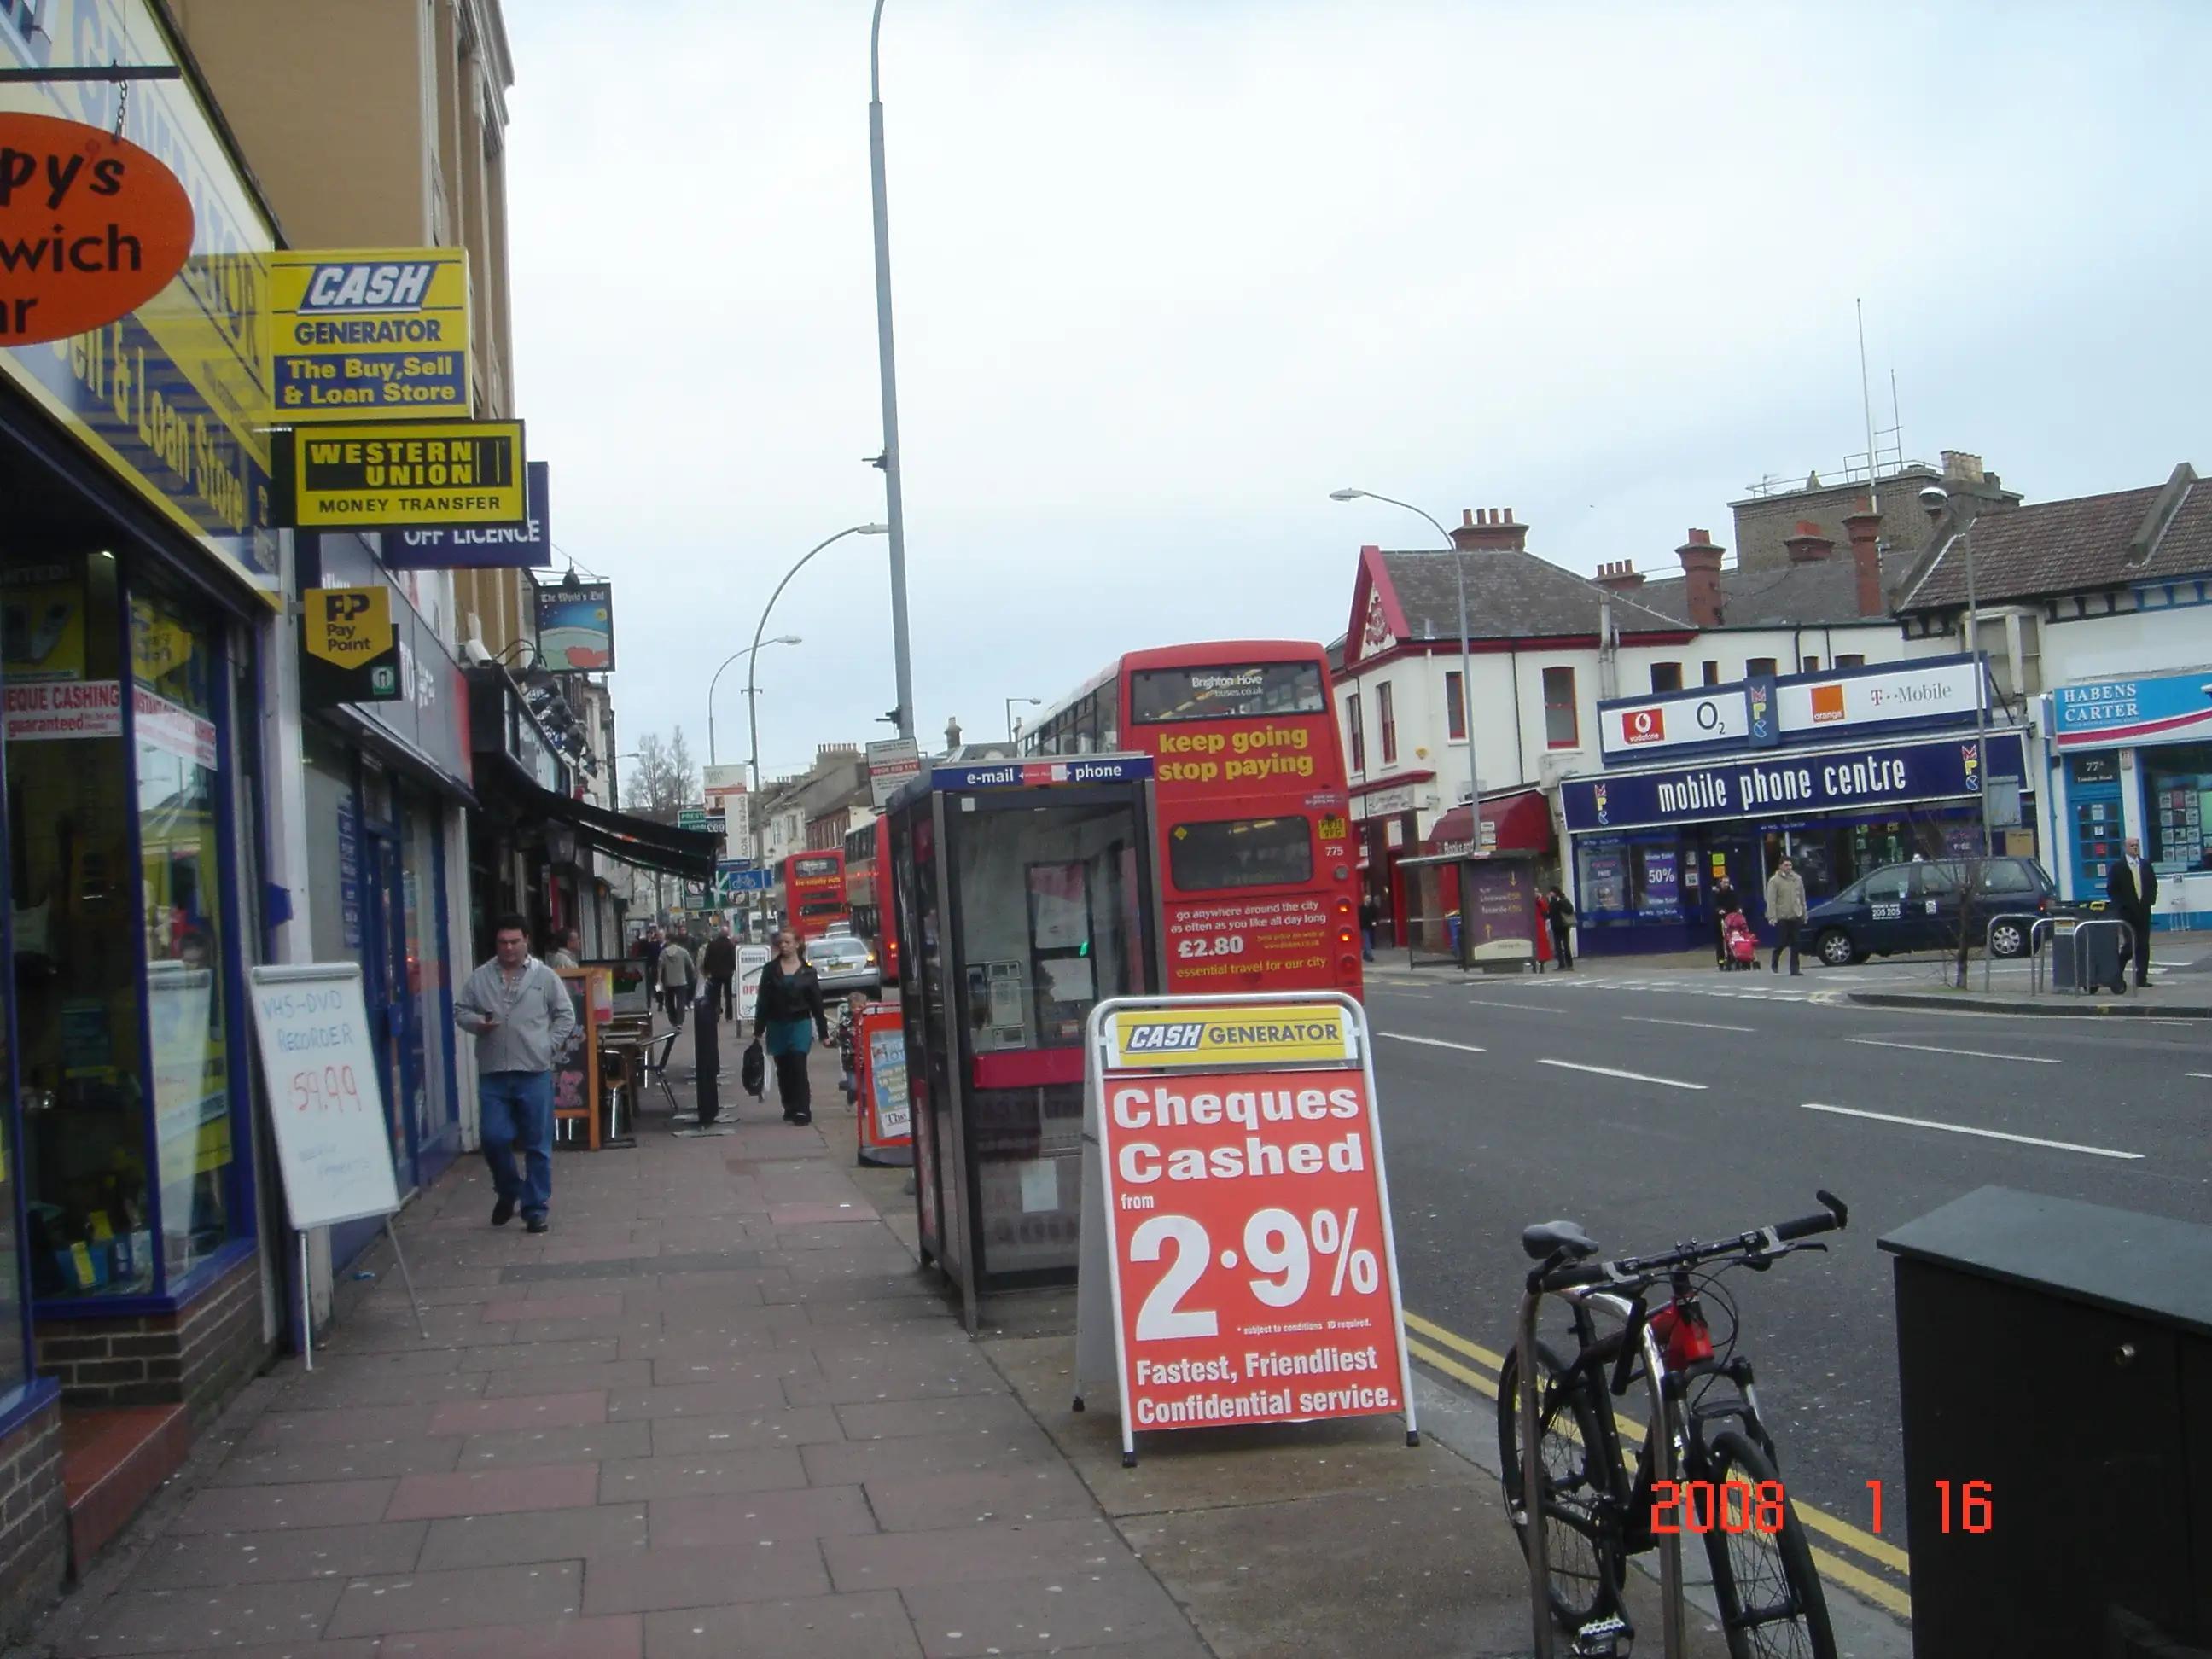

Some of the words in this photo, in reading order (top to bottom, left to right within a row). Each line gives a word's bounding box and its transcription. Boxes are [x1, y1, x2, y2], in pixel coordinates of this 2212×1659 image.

[309, 265, 430, 306] CASH
[294, 319, 443, 345] GENERATOR
[287, 359, 337, 380] The
[283, 386, 304, 405] &
[311, 383, 375, 405] Loan
[383, 382, 457, 403] Store
[138, 346, 190, 484] Loan
[195, 415, 244, 534] Store
[310, 441, 472, 464] WESTERN
[365, 464, 472, 486] UNION
[318, 498, 389, 514] MONEY
[399, 496, 501, 511] TRANSFER
[404, 529, 443, 546] OFF
[453, 519, 542, 544] LICENCE
[327, 624, 356, 640] Pay
[328, 637, 371, 652] Point
[1192, 675, 1234, 690] Brighton
[1237, 674, 1263, 685] Hove
[3, 687, 49, 712] EQUE
[53, 684, 120, 709] CASHING
[2064, 684, 2137, 703] HABENS
[1814, 710, 1842, 721] orange
[2065, 703, 2139, 722] CARTER
[8, 713, 84, 738] guaranteed
[1158, 732, 1225, 754] keep
[1231, 725, 1308, 755] going
[1629, 733, 1660, 742] vodafone
[966, 768, 1015, 785] e-mail
[1075, 763, 1122, 781] phone
[1158, 760, 1218, 783] stop
[1225, 754, 1313, 780] paying
[1658, 773, 1727, 812] mobile
[1739, 768, 1812, 811] phone
[1824, 756, 1906, 796] centre
[1325, 845, 1344, 857] 775
[1649, 868, 1675, 883] 50%
[1176, 911, 1190, 922] go
[1192, 905, 1242, 920] anywhere
[1244, 904, 1280, 915] around
[1282, 902, 1299, 911] the
[1301, 900, 1319, 911] city
[1170, 925, 1183, 934] as
[1185, 922, 1212, 933] often
[1214, 922, 1226, 930] as
[1228, 920, 1248, 931] you
[1249, 917, 1268, 928] like
[1270, 917, 1282, 926] all
[1284, 915, 1302, 927] day
[1304, 913, 1327, 925] long
[1178, 935, 1244, 958] £2.80
[1176, 963, 1227, 978] essential
[1230, 961, 1263, 974] travel
[1266, 960, 1282, 971] for
[1285, 959, 1304, 969] our
[1307, 957, 1328, 969] city
[1130, 1024, 1202, 1049] CASH
[1208, 1024, 1340, 1045] GENERATOR
[1113, 1088, 1359, 1132] Cheques
[1118, 1133, 1365, 1184] Cashed
[1121, 1193, 1155, 1210] from
[1243, 1325, 1272, 1336] subject
[1273, 1324, 1282, 1333] to
[1283, 1322, 1323, 1332] conditions
[1136, 1356, 1238, 1386] Fastest,
[1244, 1345, 1378, 1378] Friendliest
[1137, 1388, 1292, 1424] Confidential
[1299, 1383, 1398, 1415] service.
